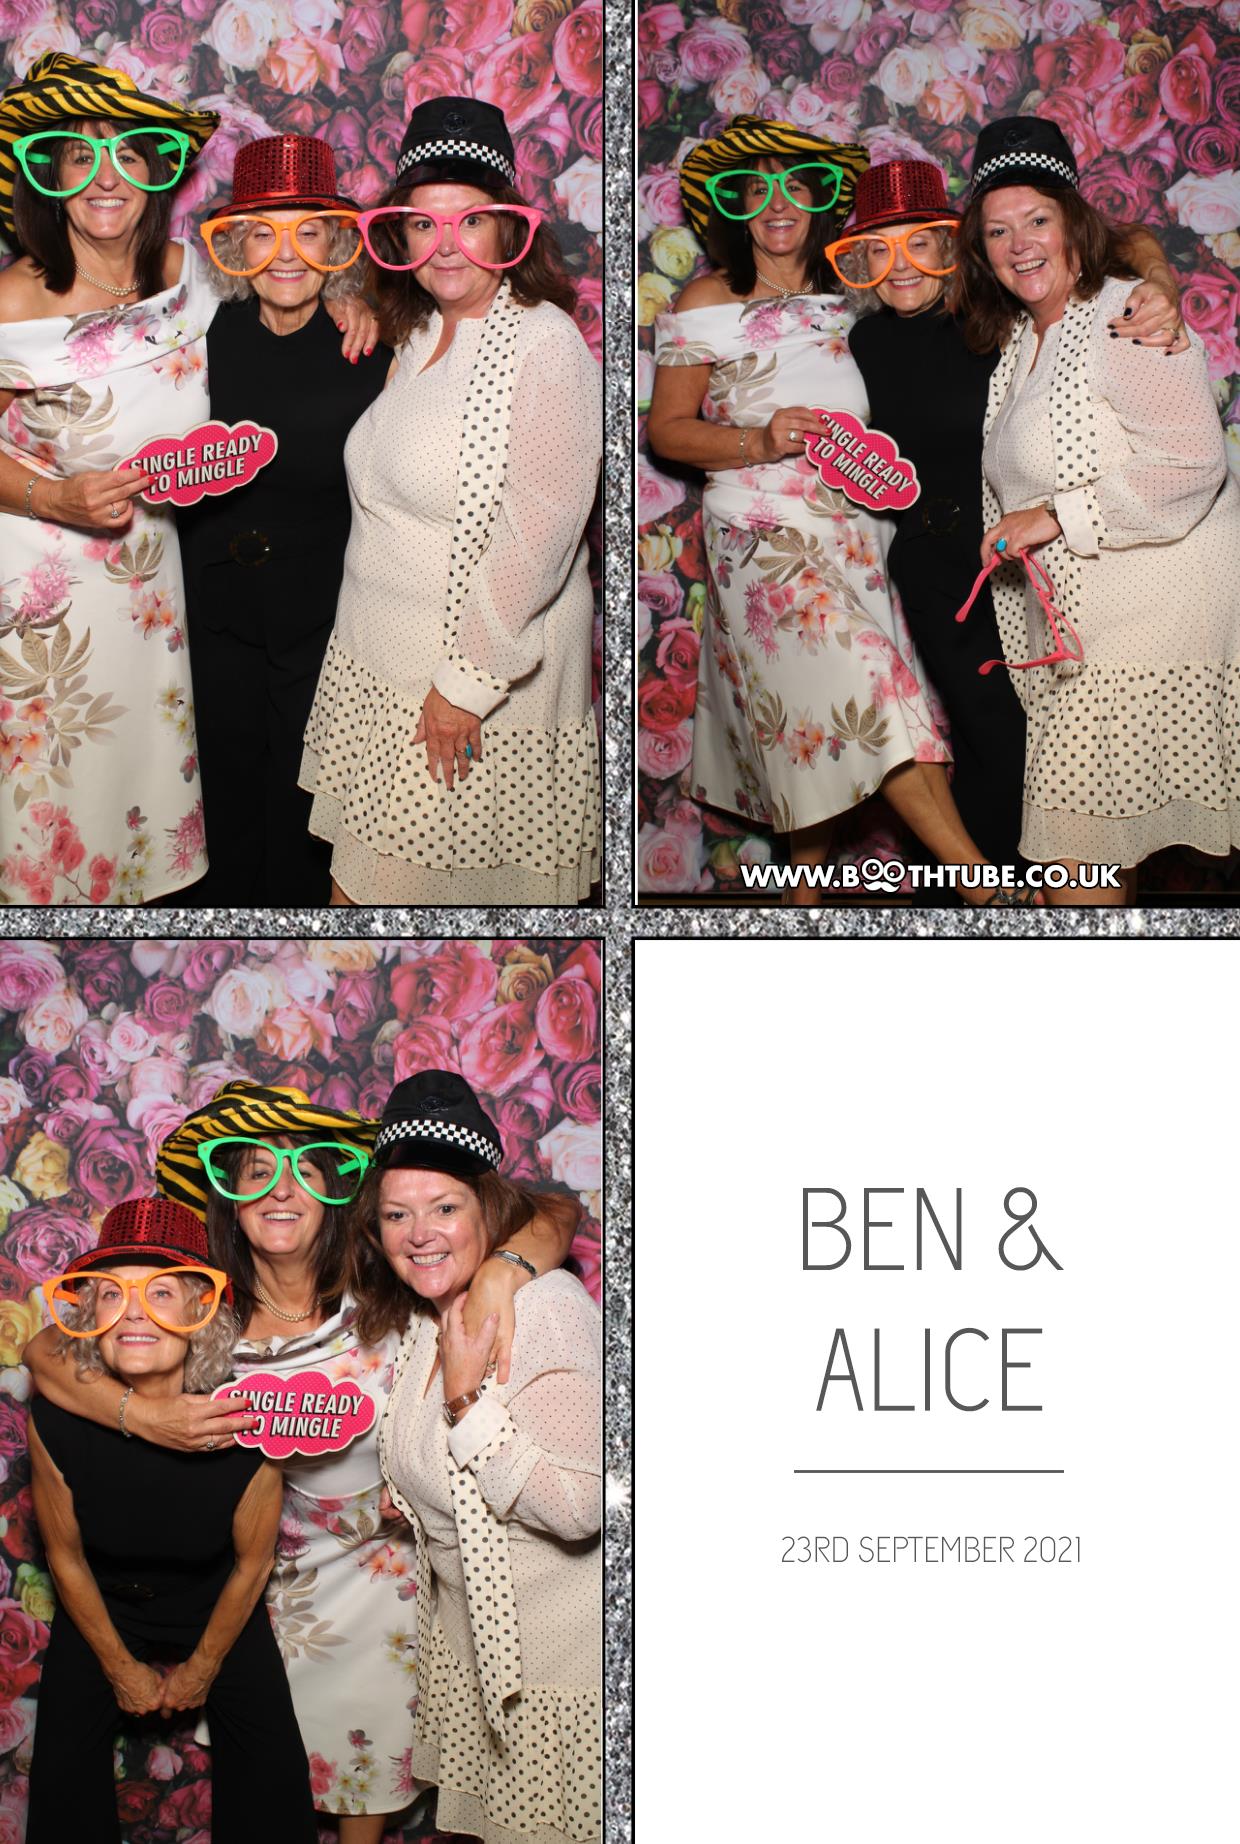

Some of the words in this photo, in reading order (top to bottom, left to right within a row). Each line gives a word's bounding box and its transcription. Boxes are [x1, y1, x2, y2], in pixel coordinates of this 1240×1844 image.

[203, 433, 262, 462] READY
[177, 457, 245, 488] MINGLE
[813, 436, 836, 459] TO
[832, 453, 888, 500] MINGLE
[862, 451, 913, 493] READY
[301, 1393, 364, 1416] READY
[271, 1416, 343, 1438] MINGLE
